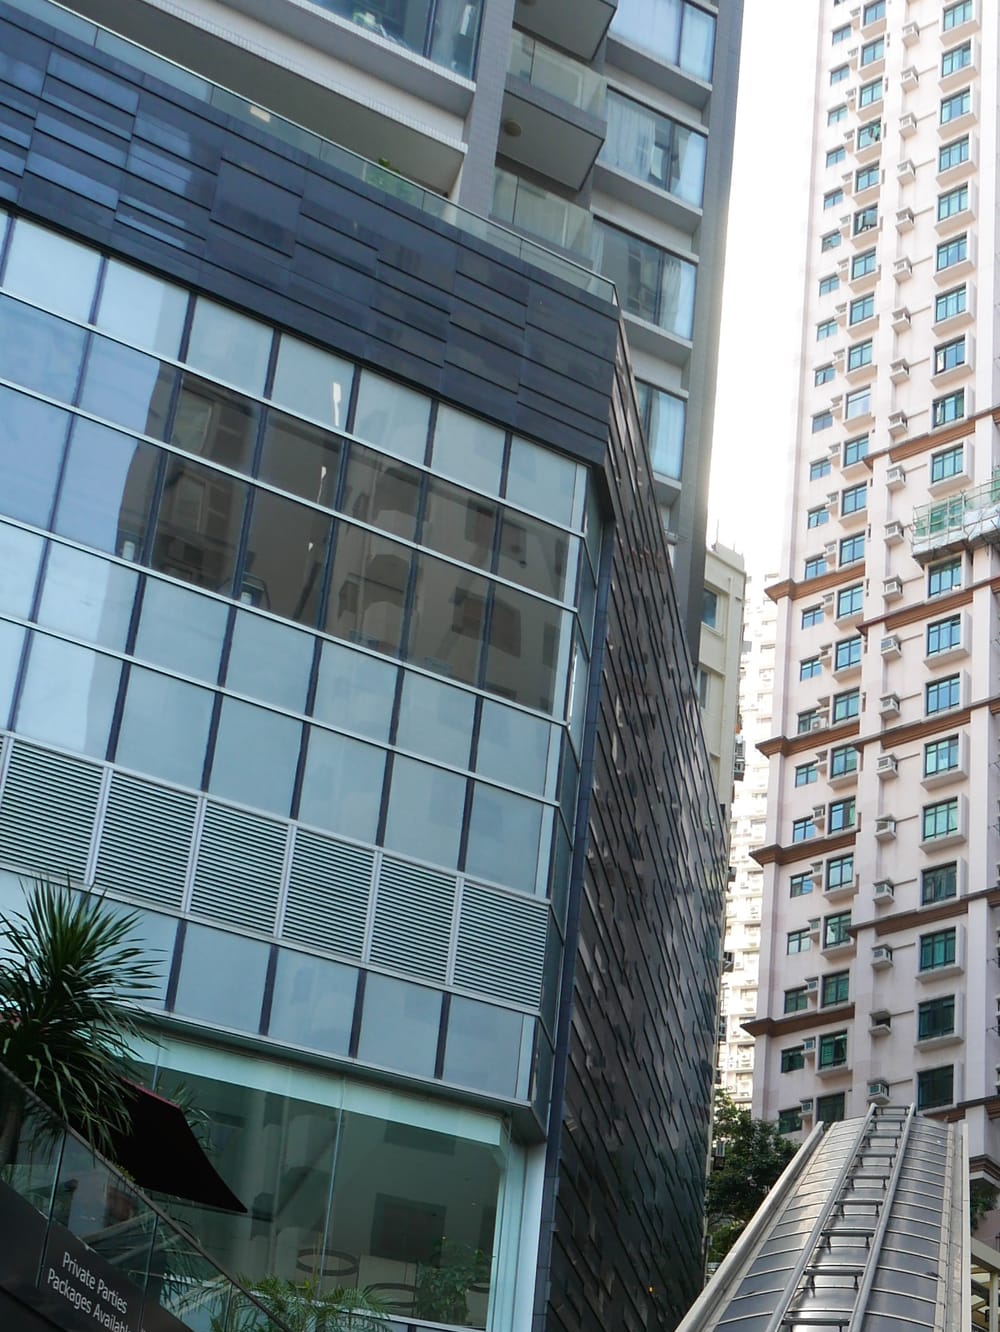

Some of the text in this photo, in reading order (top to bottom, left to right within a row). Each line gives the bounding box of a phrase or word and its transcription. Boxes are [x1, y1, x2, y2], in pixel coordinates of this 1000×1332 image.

[47, 1268, 92, 1314] Packages
[63, 1251, 128, 1315] Private Parties
